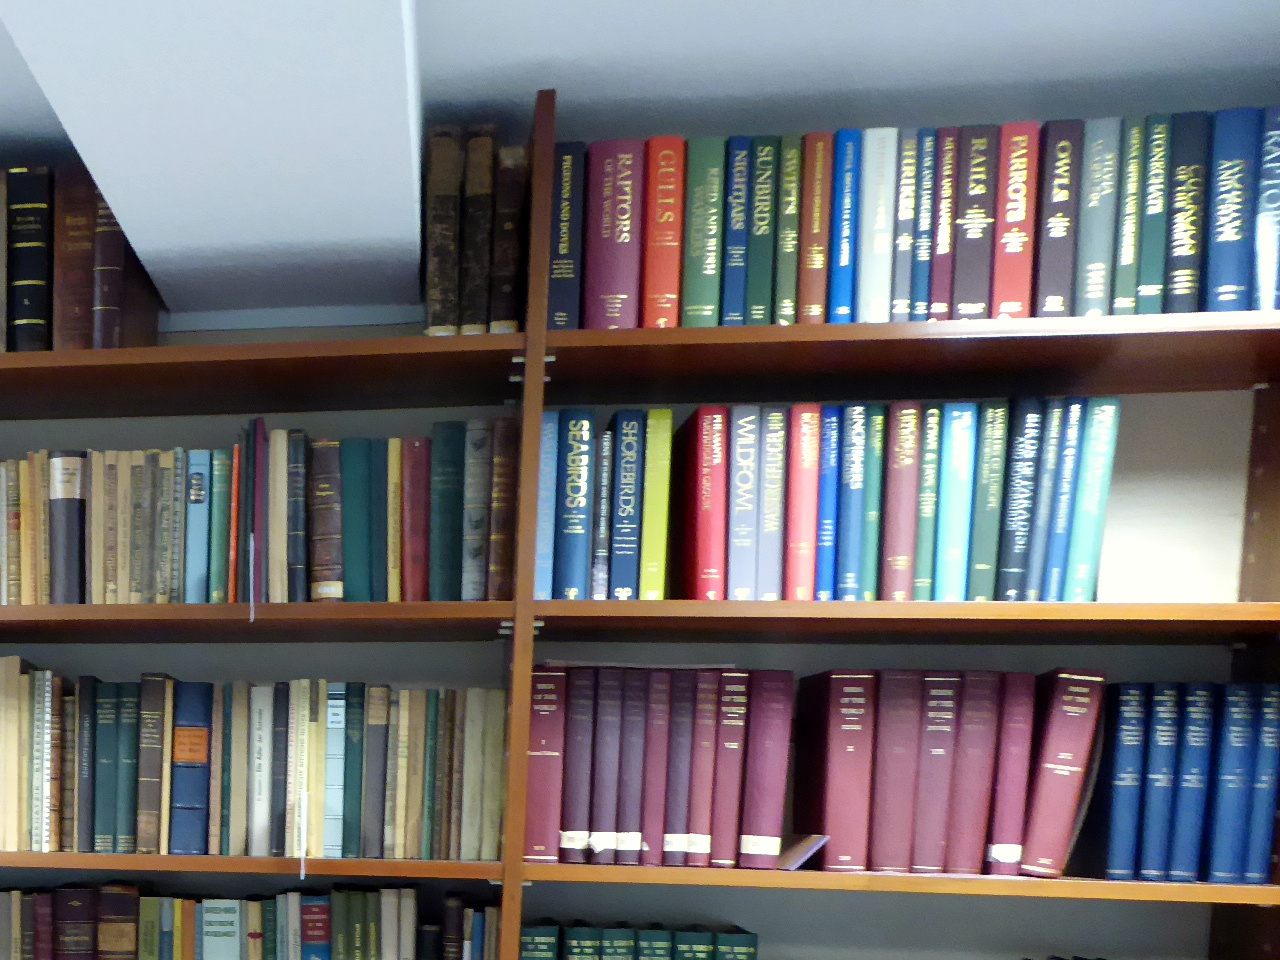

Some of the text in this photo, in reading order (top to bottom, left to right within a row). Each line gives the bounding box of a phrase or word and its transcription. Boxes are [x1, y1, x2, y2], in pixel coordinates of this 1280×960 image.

[615, 153, 634, 244] RAPTORS
[656, 150, 678, 224] GULLS
[728, 150, 748, 231] NIGHTJARS
[752, 146, 774, 236] SUNBIRDS
[969, 138, 989, 196] RAILS
[1005, 135, 1029, 222] PARROTS
[1051, 140, 1072, 203] OWLS
[566, 420, 590, 508] SEABIRDS
[618, 421, 639, 517] SHOREBIRDS
[734, 415, 758, 514] WILDFOWL
